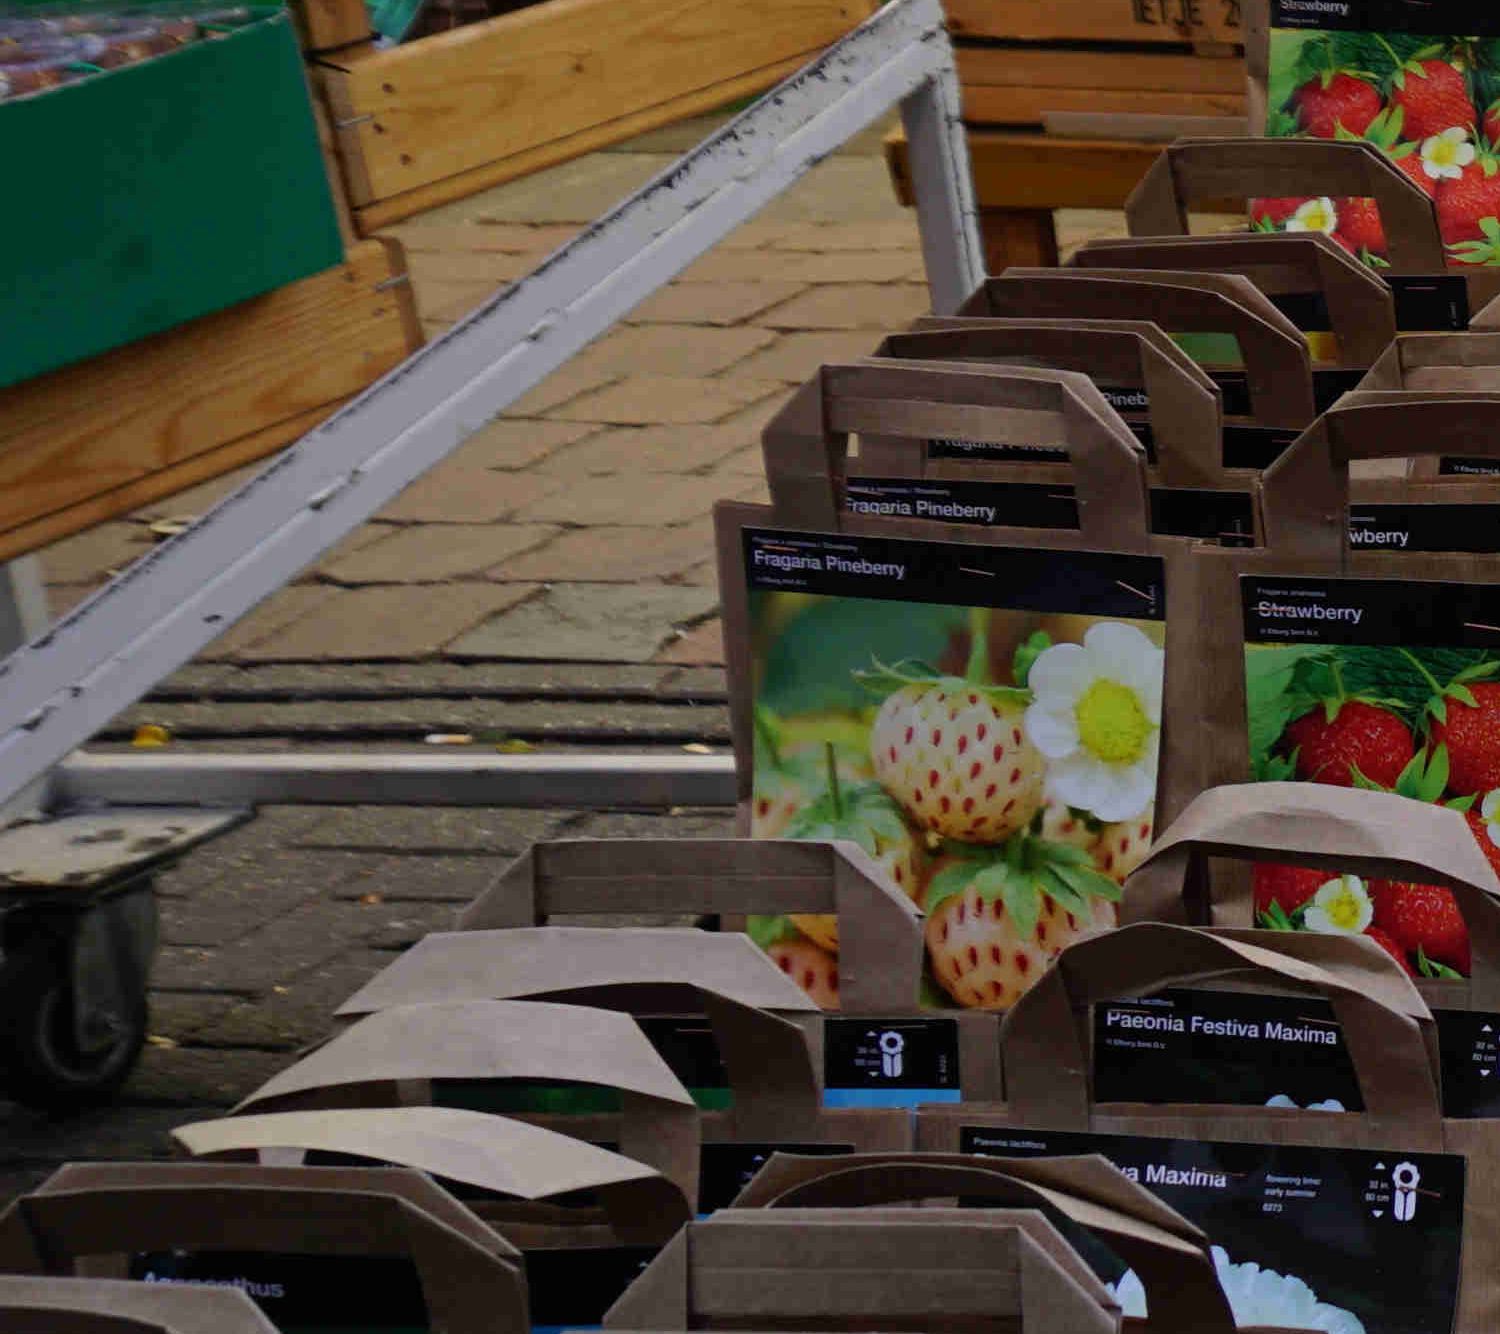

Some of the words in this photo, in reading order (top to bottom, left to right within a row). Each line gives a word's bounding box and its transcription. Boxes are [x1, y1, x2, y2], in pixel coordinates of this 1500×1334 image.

[915, 499, 998, 522] Pineberry
[1349, 529, 1410, 547] wberry
[753, 549, 824, 572] Fragaria
[825, 555, 907, 581] Pineberry
[1257, 600, 1363, 626] Strawberry
[1106, 1009, 1184, 1033] Paeonia
[1190, 1014, 1260, 1039] Festiva
[1263, 1020, 1338, 1046] Maxima
[1144, 1162, 1228, 1189] Maxima
